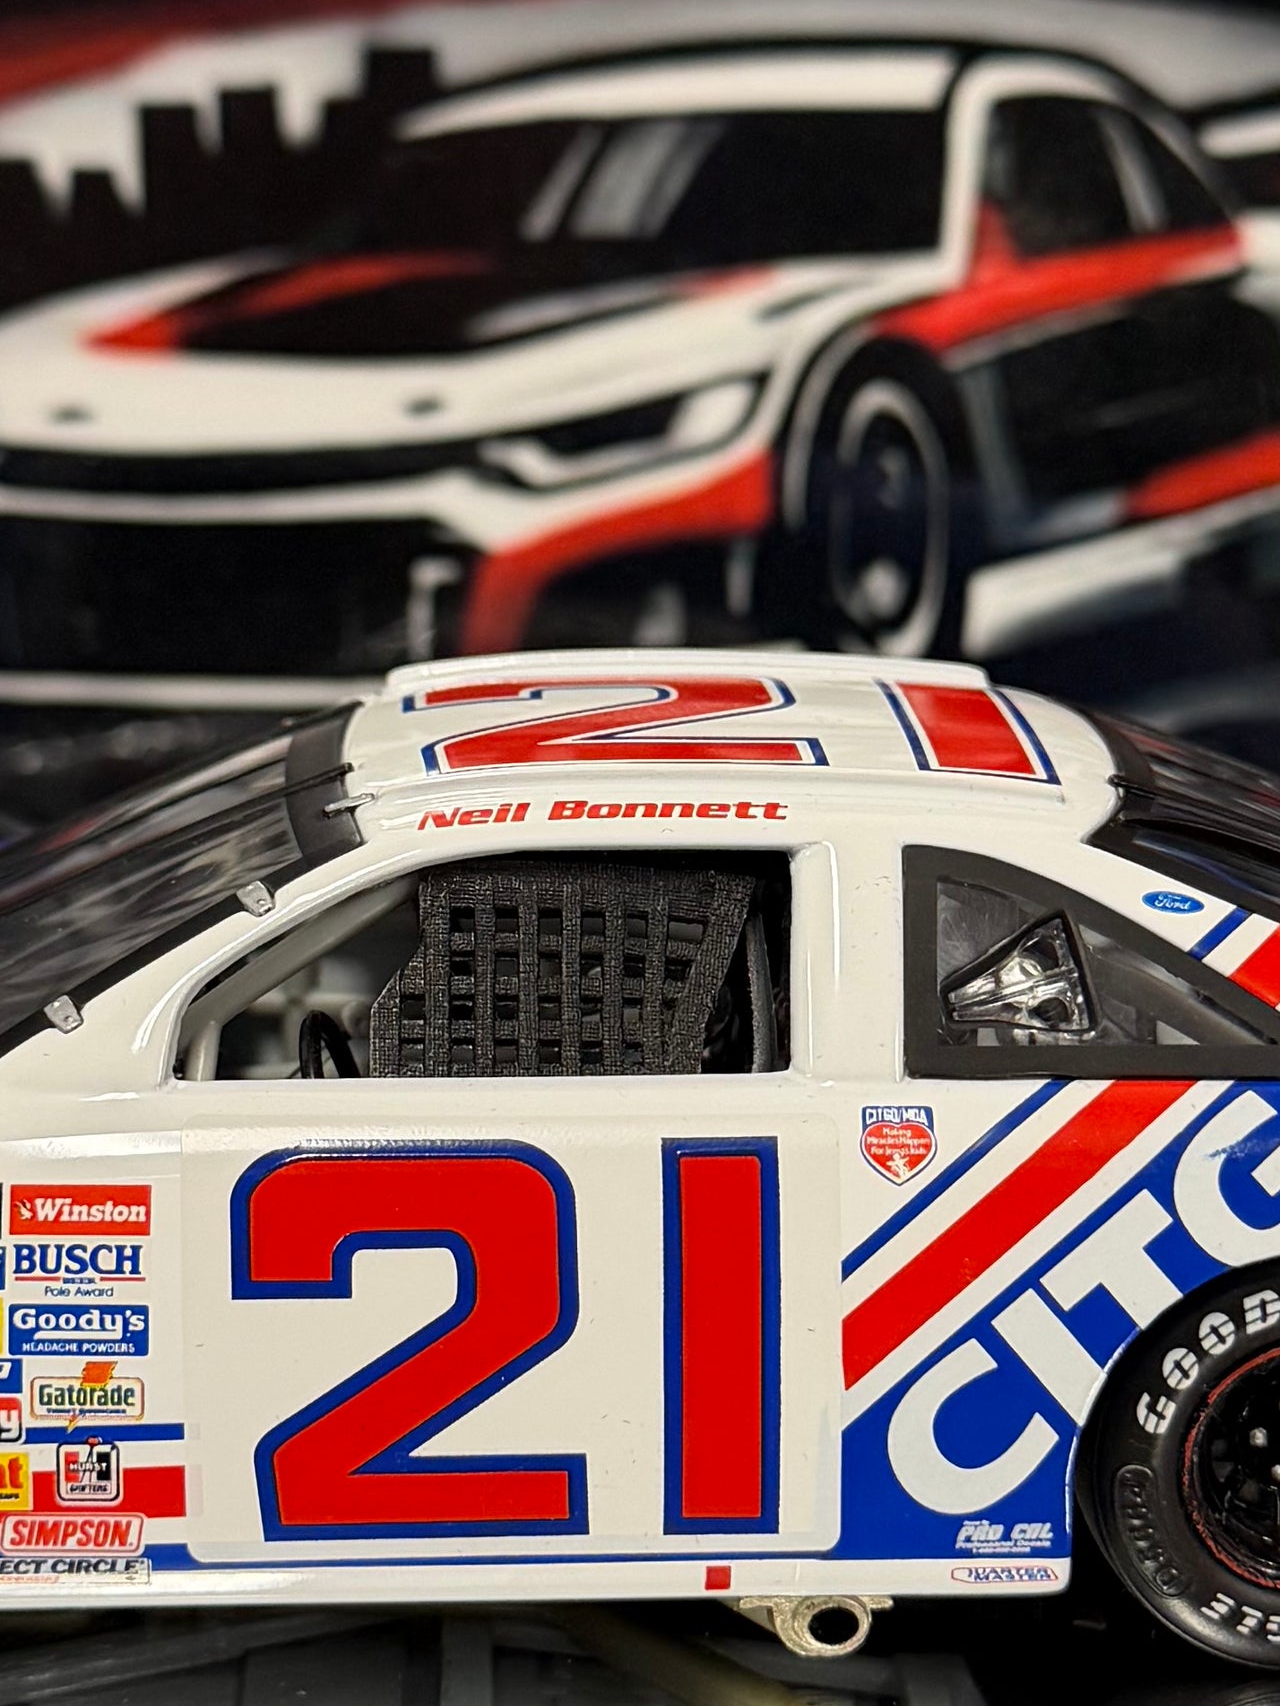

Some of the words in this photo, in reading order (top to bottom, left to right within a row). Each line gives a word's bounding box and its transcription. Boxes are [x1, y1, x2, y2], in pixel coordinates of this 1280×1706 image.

[402, 676, 1061, 786] 21
[417, 802, 531, 830] Neil
[547, 800, 788, 820] Bonnett
[34, 1197, 147, 1222] Winston
[12, 1244, 143, 1274] BUSCH
[44, 1285, 70, 1297] Pole
[74, 1286, 114, 1297] Award
[12, 1308, 145, 1336] Goody's
[22, 1342, 79, 1353] HEADACHE
[82, 1342, 135, 1353] POWDERS
[231, 1137, 780, 1541] 21
[39, 1384, 136, 1407] Gatorade
